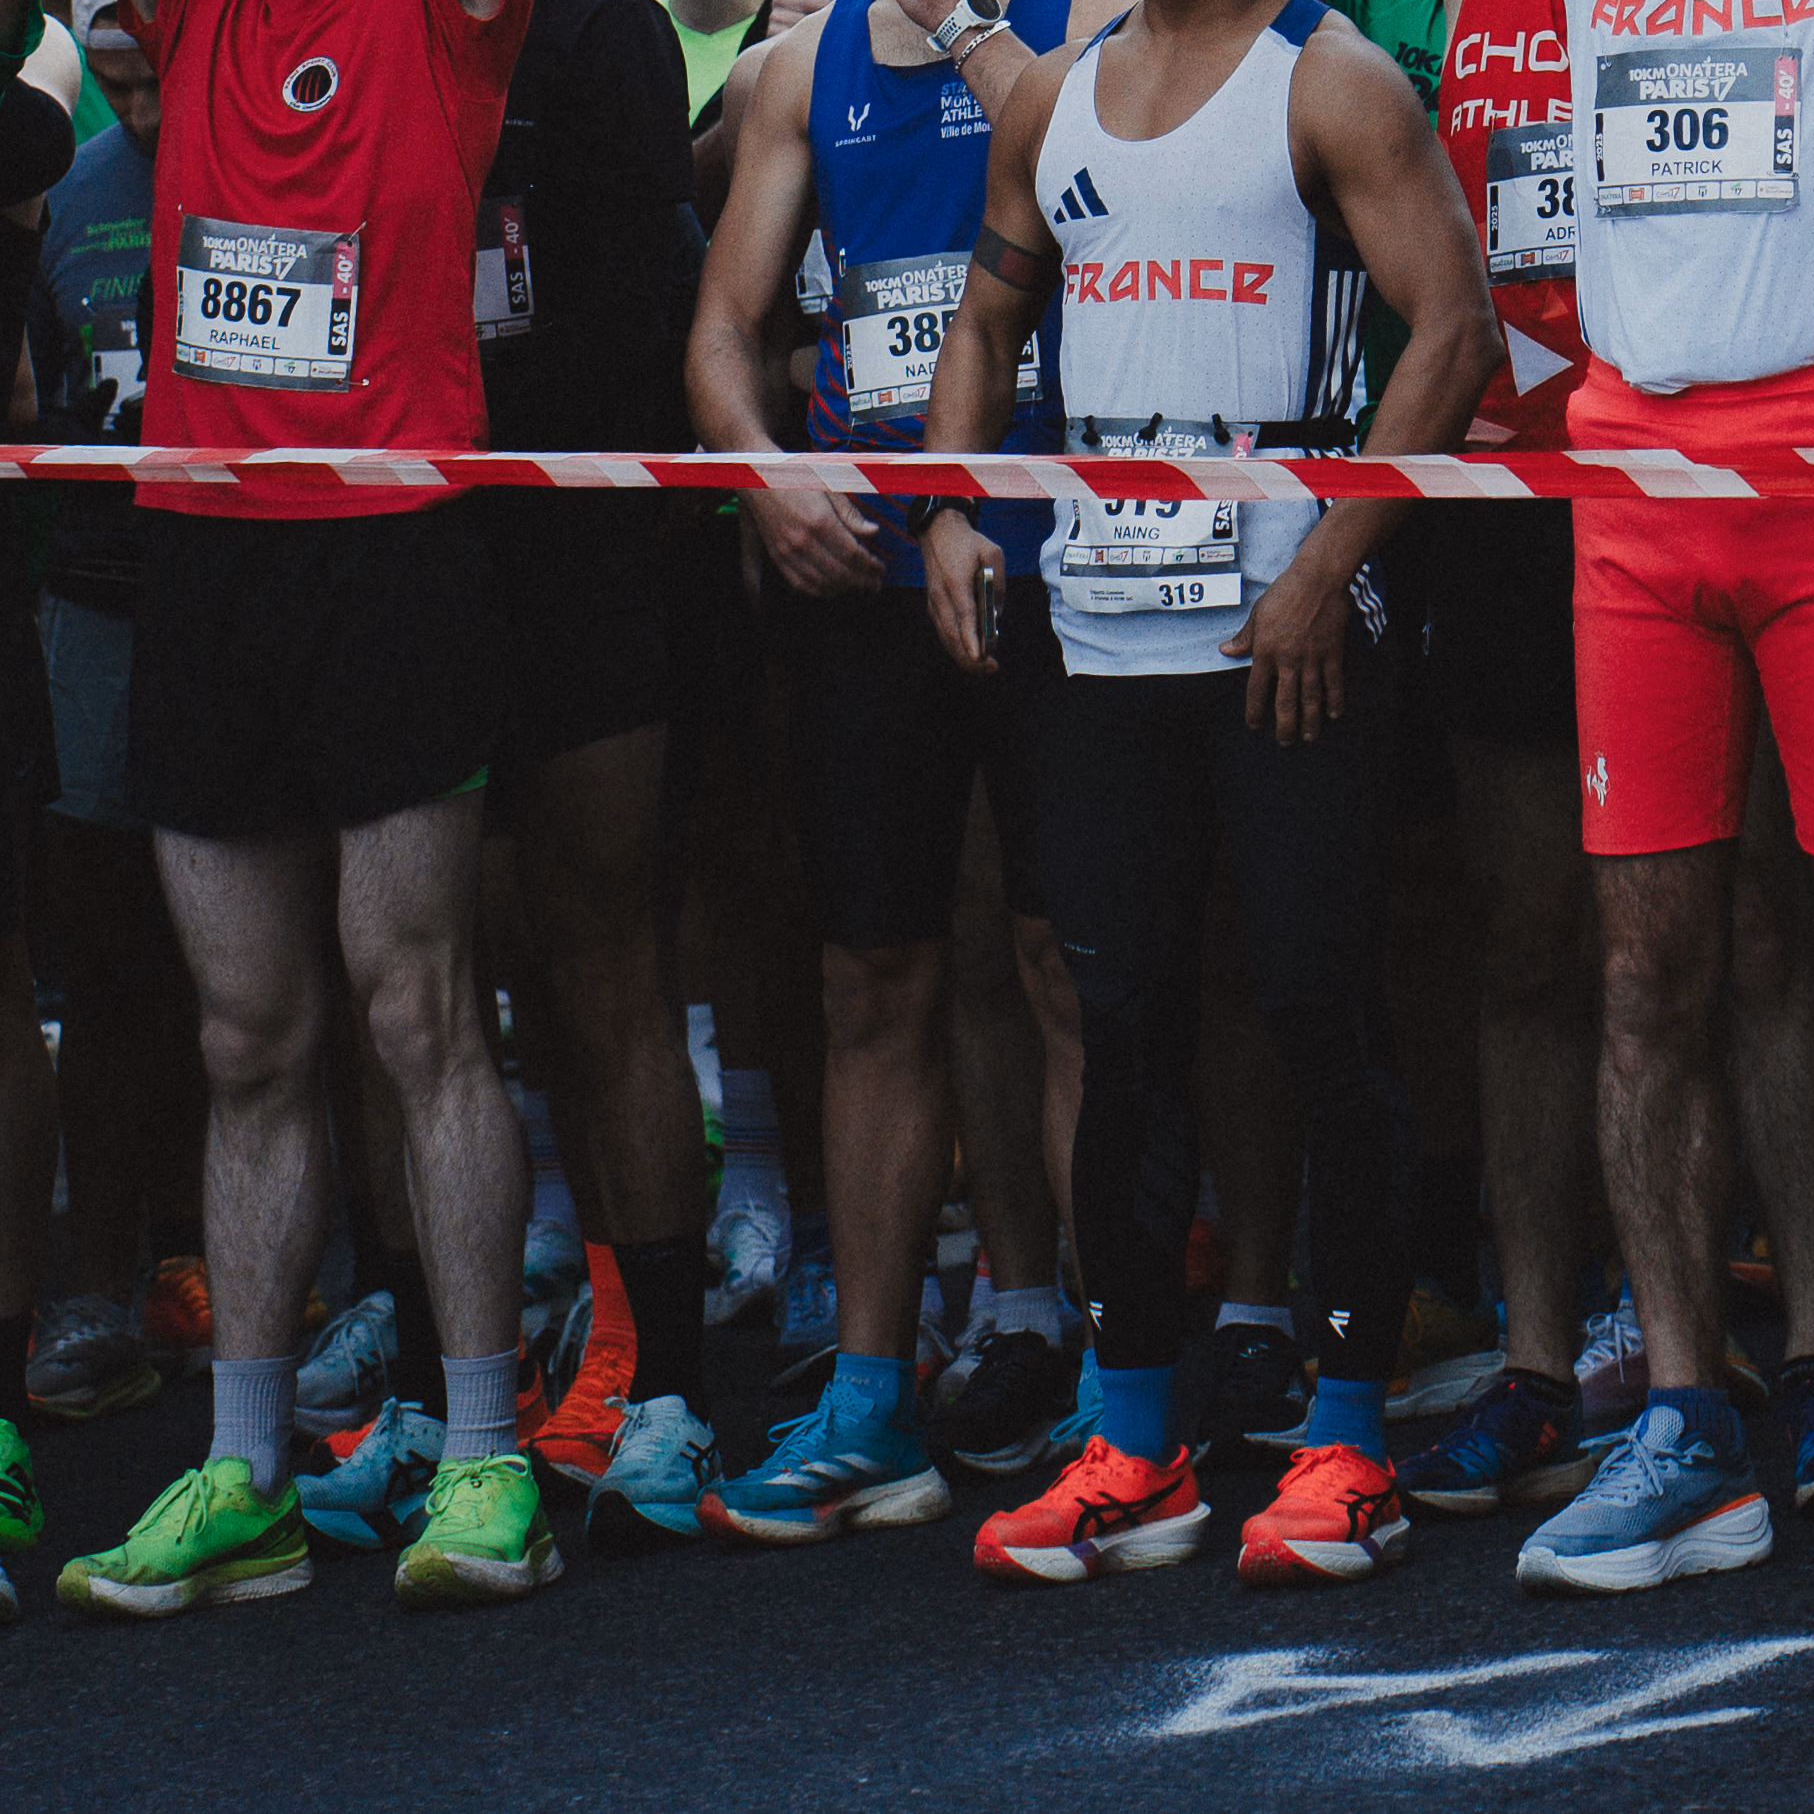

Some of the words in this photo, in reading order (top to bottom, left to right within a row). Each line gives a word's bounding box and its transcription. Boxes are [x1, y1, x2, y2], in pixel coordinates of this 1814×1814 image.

[1395, 42, 1443, 77] 10K
[1646, 108, 1729, 152] 306
[1776, 127, 1792, 165] SAS
[1651, 160, 1723, 176] PATRICK
[510, 272, 525, 304] SAS
[1064, 259, 1274, 305] FRANCE
[201, 277, 302, 328] 8867
[209, 329, 280, 350] RAPHAEL
[331, 311, 349, 347] SAS
[1113, 525, 1160, 540] NAING
[1159, 582, 1204, 607] 319
